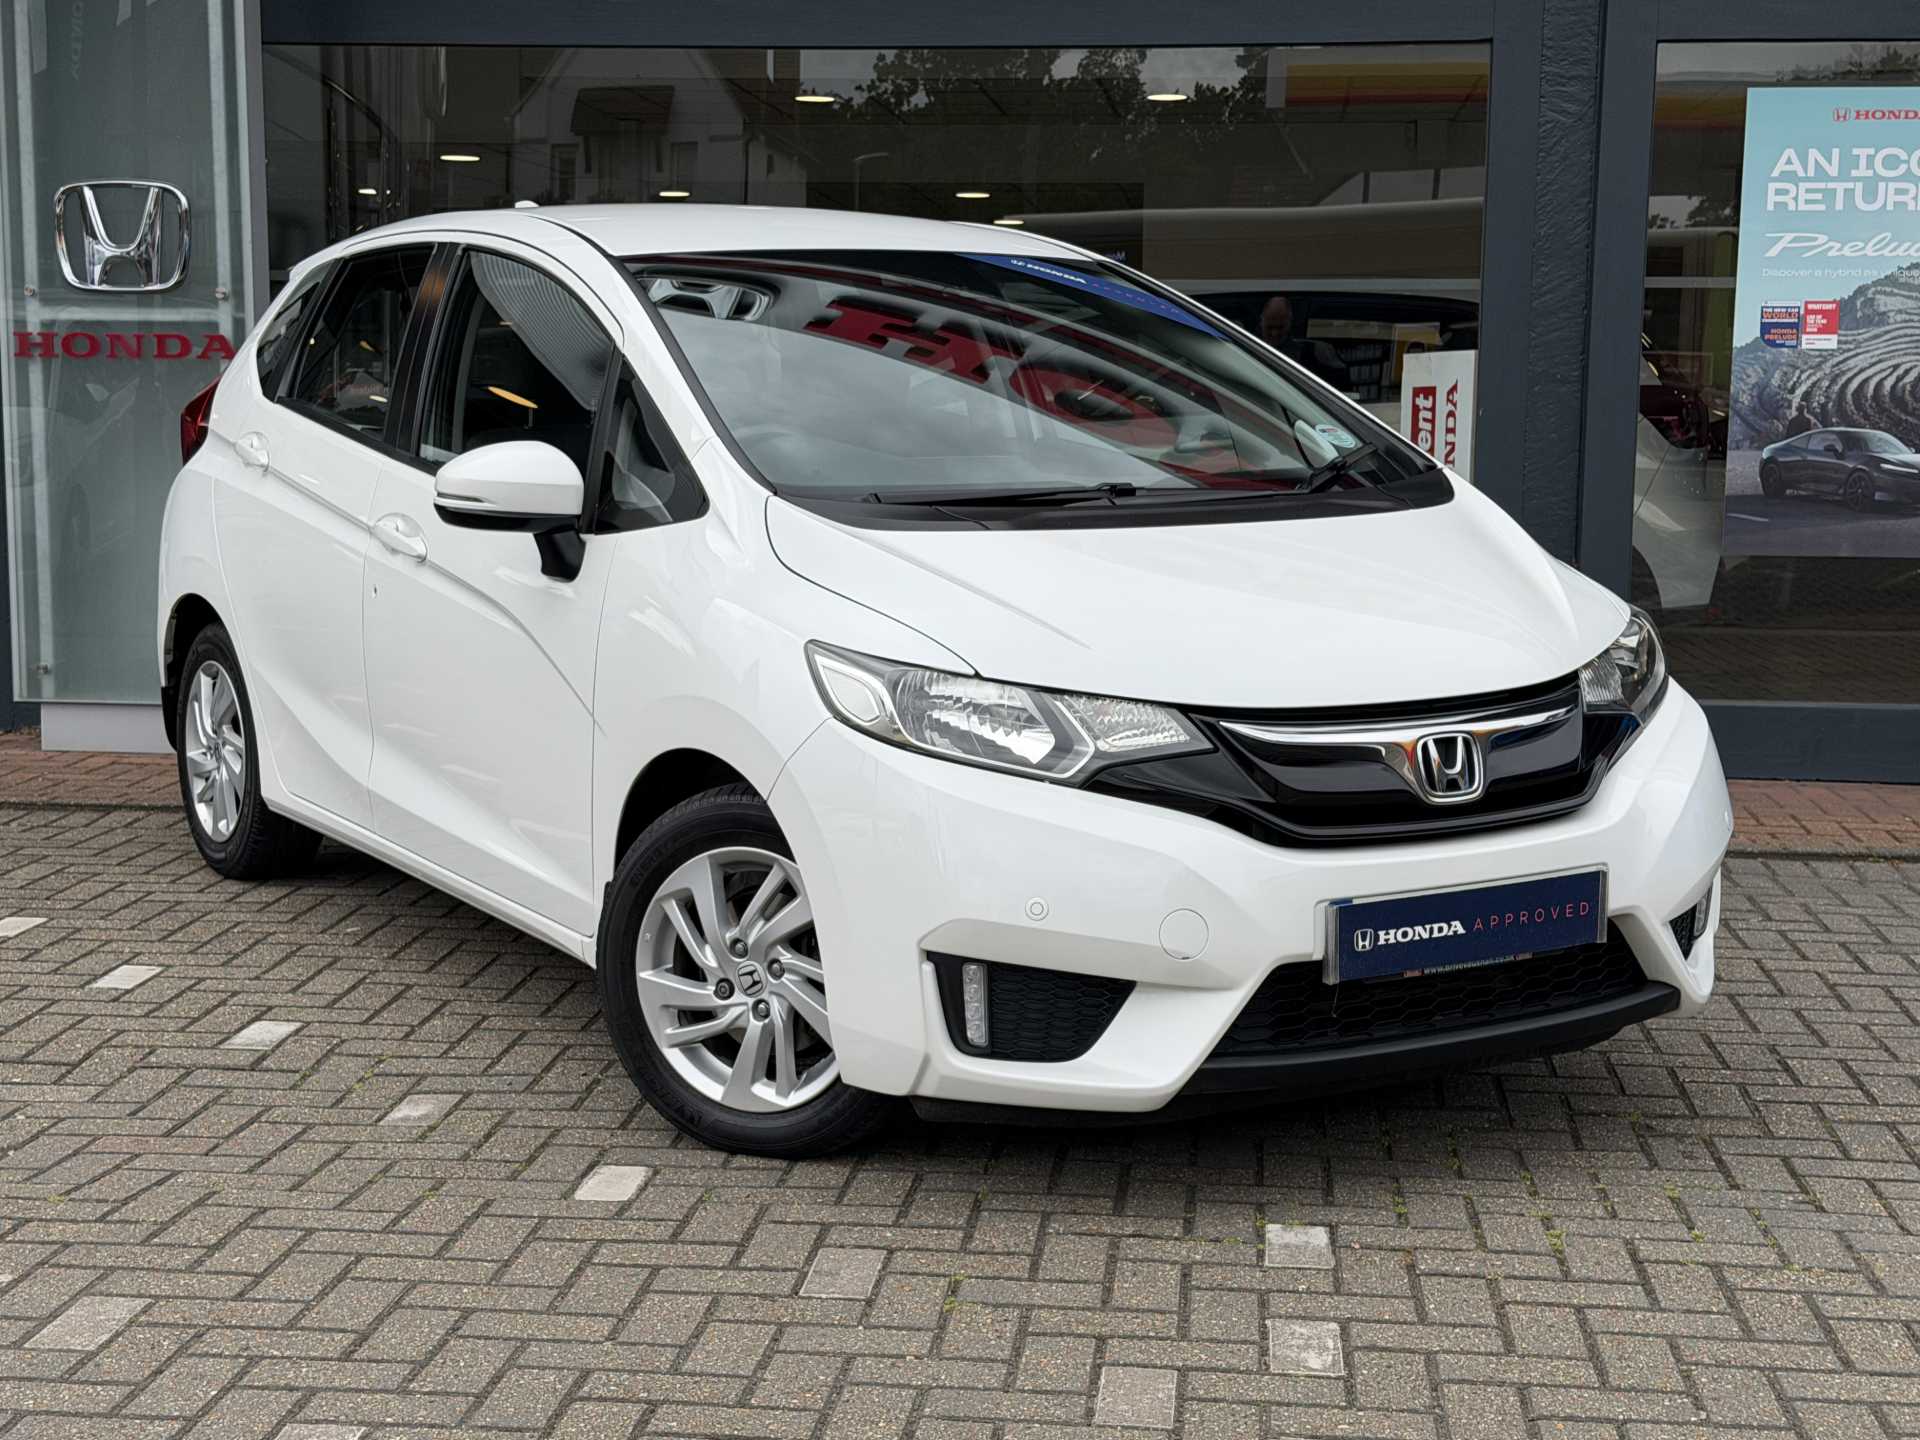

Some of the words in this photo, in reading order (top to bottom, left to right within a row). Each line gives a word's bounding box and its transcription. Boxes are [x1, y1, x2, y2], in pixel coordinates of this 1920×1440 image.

[1855, 109, 1920, 120] HOND
[1771, 147, 1839, 177] AN
[1851, 147, 1920, 177] IC
[1766, 182, 1920, 211] RETUR
[13, 330, 236, 361] HONDA
[1377, 920, 1466, 945] HONDA
[1473, 902, 1590, 931] APPROVED
